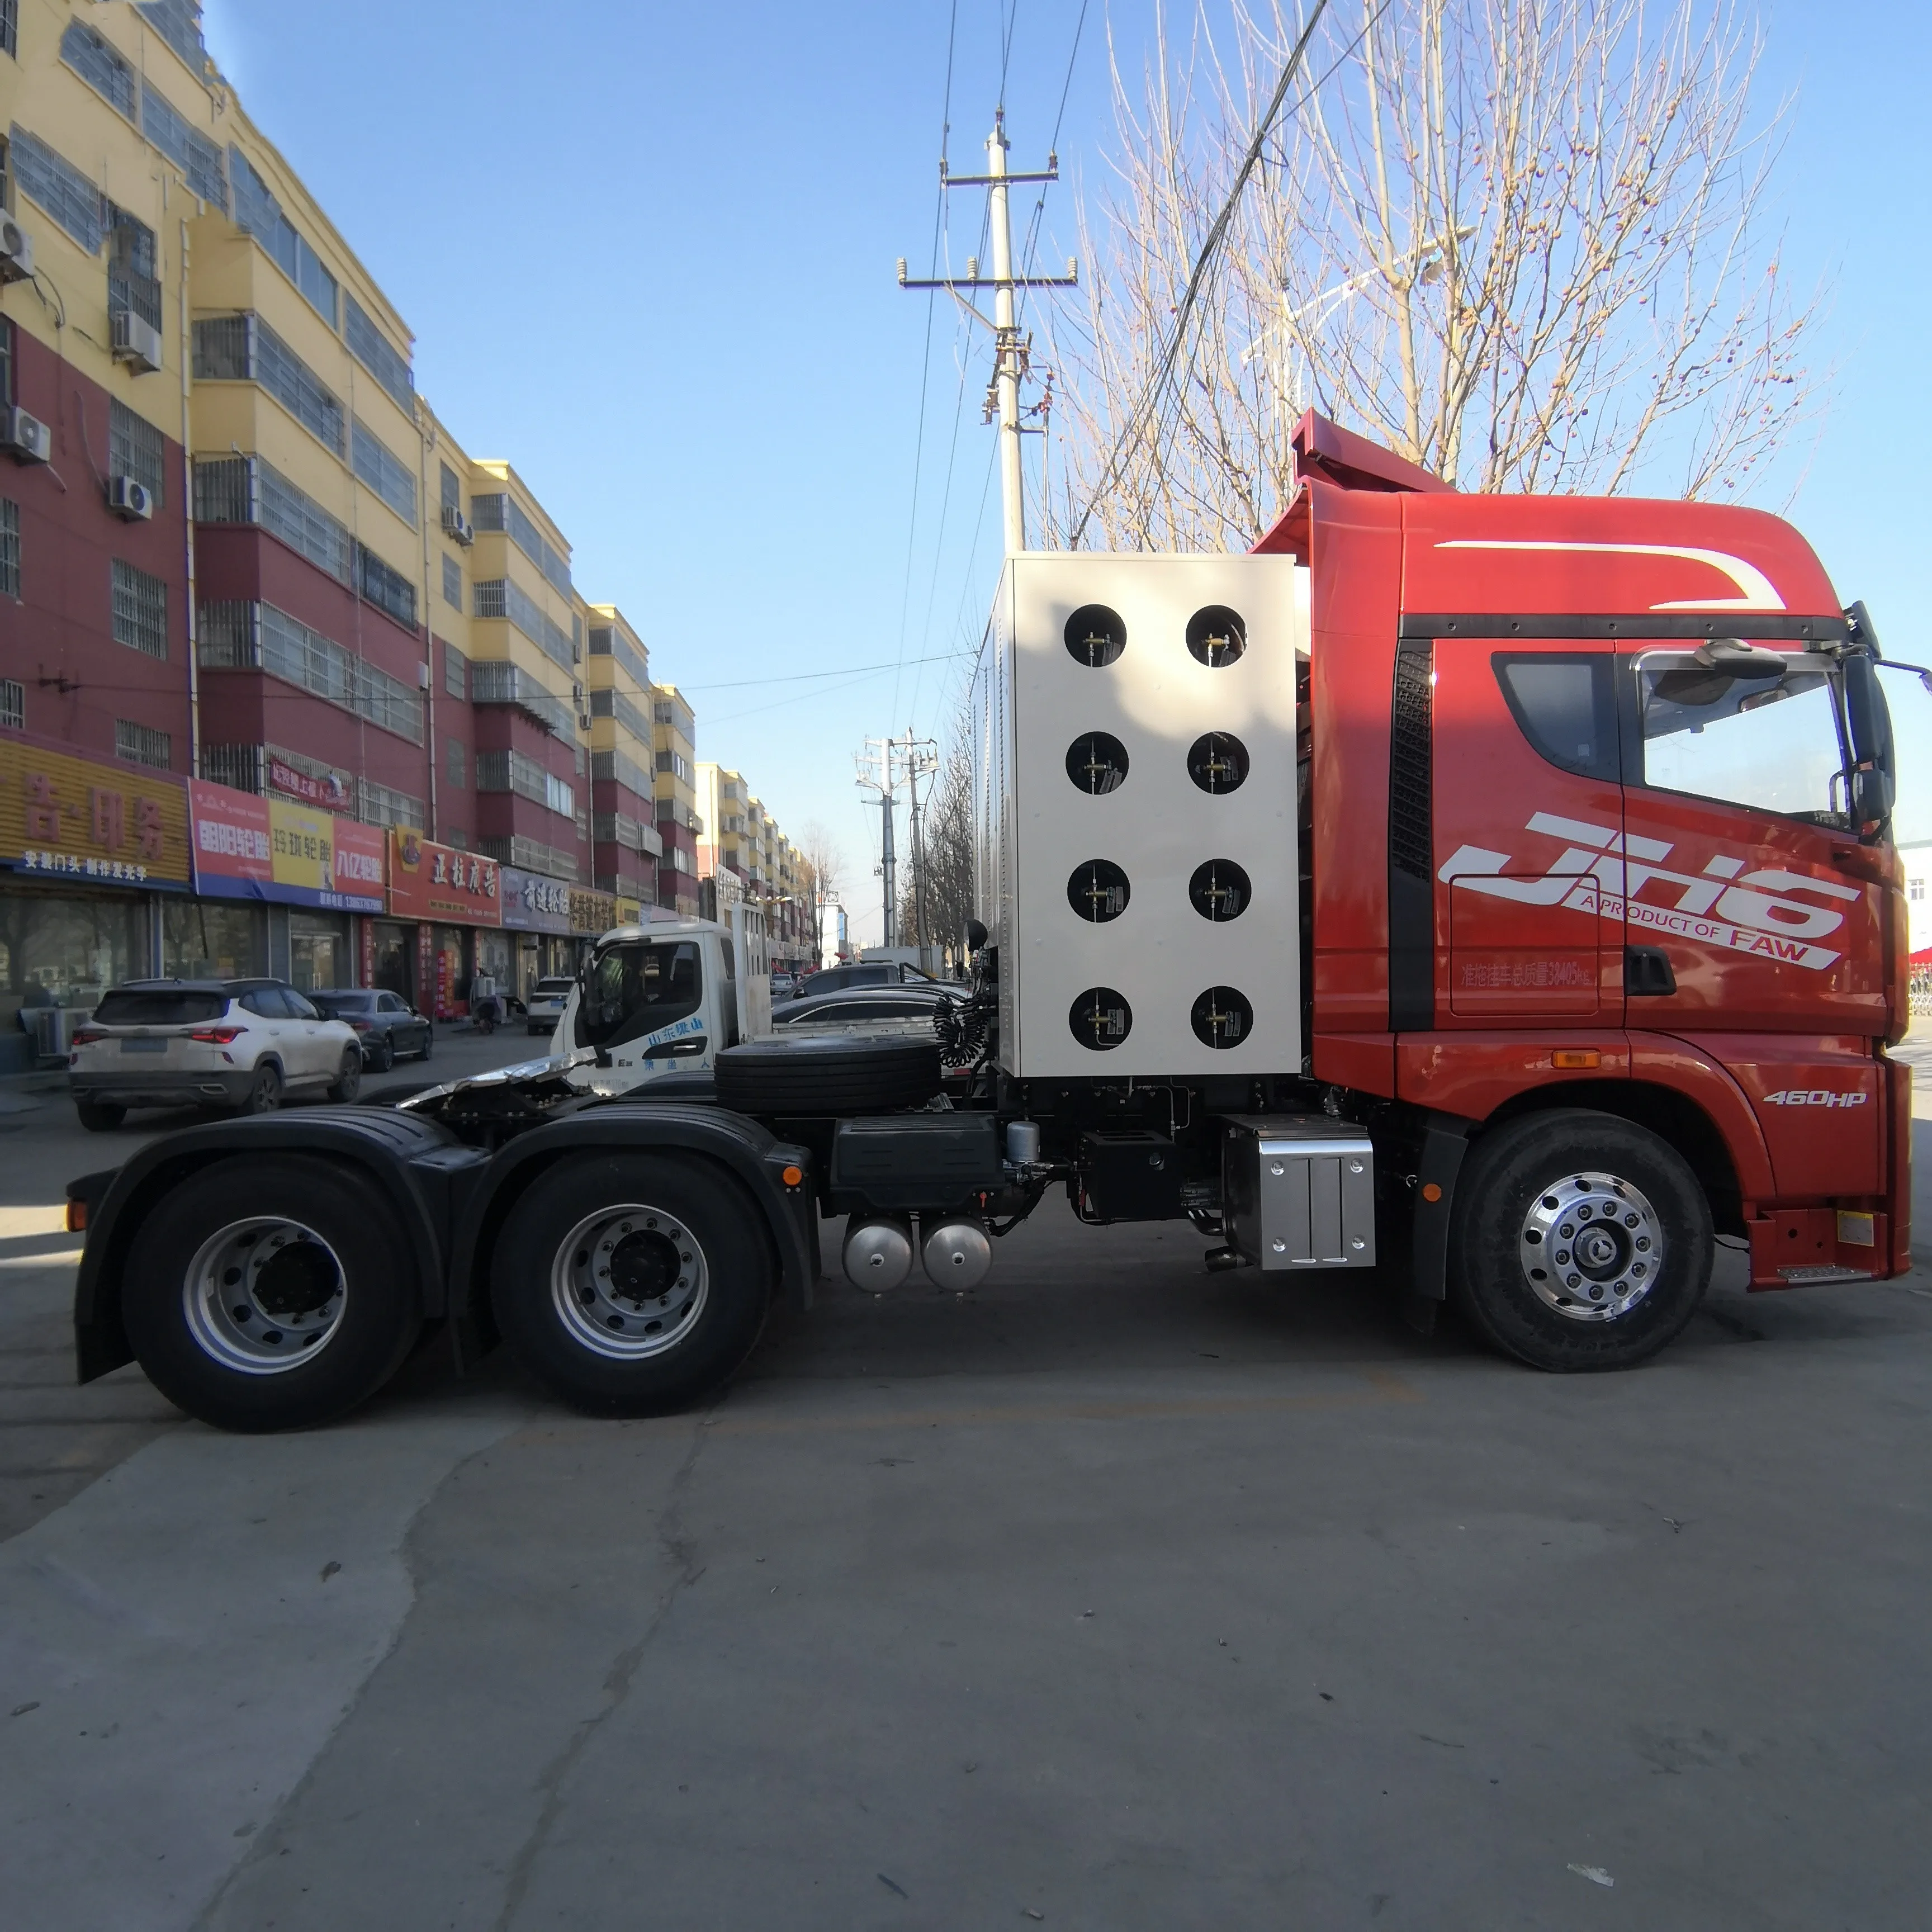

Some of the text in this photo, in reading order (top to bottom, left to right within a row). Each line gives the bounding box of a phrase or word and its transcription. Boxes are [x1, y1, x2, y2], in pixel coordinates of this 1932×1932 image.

[199, 820, 270, 860] 朝阳轮胎
[23, 850, 80, 873] 安装门头
[336, 850, 382, 883] 八亿轮胎
[1580, 896, 1808, 962] A PRODUCT OF FAW
[648, 1017, 704, 1046] 山东梁山
[1763, 1090, 1867, 1107] 460HP
